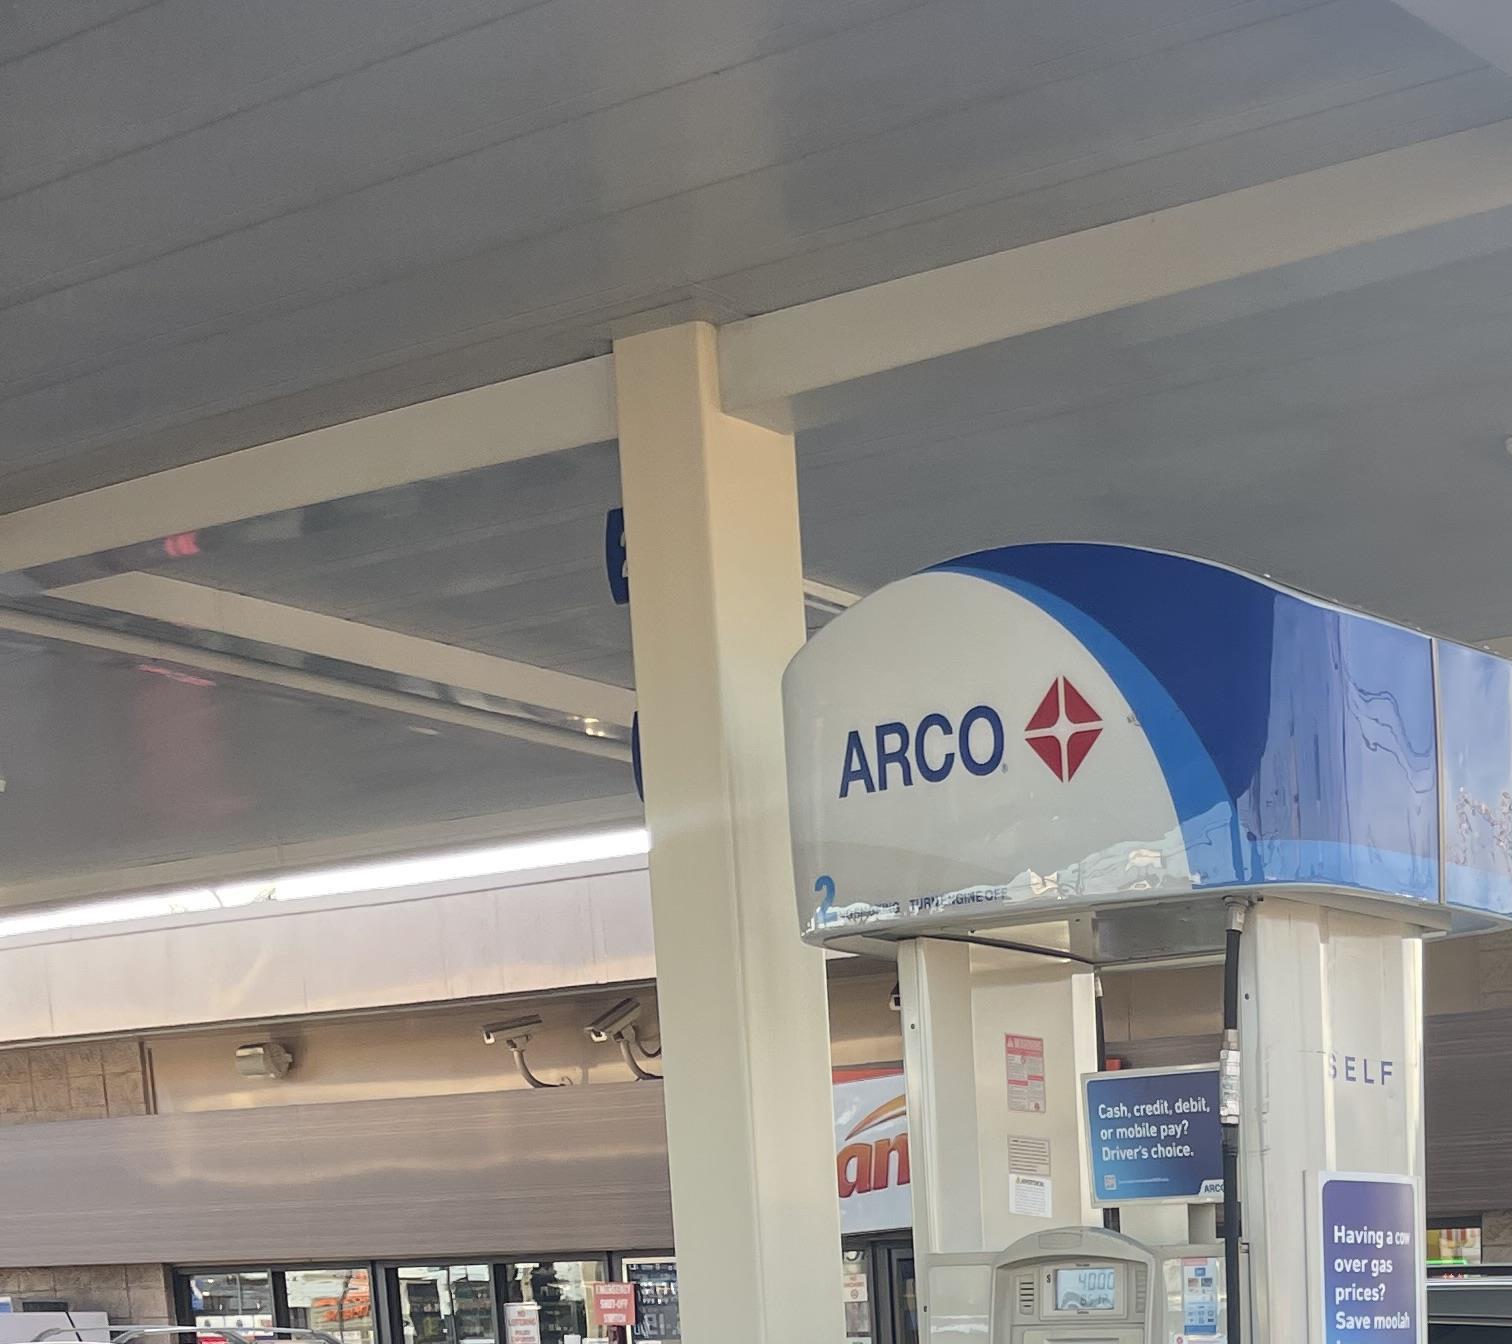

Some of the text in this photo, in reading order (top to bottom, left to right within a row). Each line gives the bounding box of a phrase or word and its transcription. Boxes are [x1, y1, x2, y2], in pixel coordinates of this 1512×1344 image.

[838, 705, 1004, 798] ARCO
[814, 875, 838, 923] 2
[1329, 1051, 1393, 1086] SELF
[1098, 1096, 1210, 1119] Cash, credit, debit,
[1100, 1119, 1189, 1140] or mobile pay?
[1102, 1142, 1194, 1161] Driver's choice.
[1333, 1225, 1410, 1248] Having a cow
[1334, 1258, 1393, 1277] over gas
[1335, 1283, 1385, 1305] prices?
[1335, 1311, 1410, 1330] Save moolah
